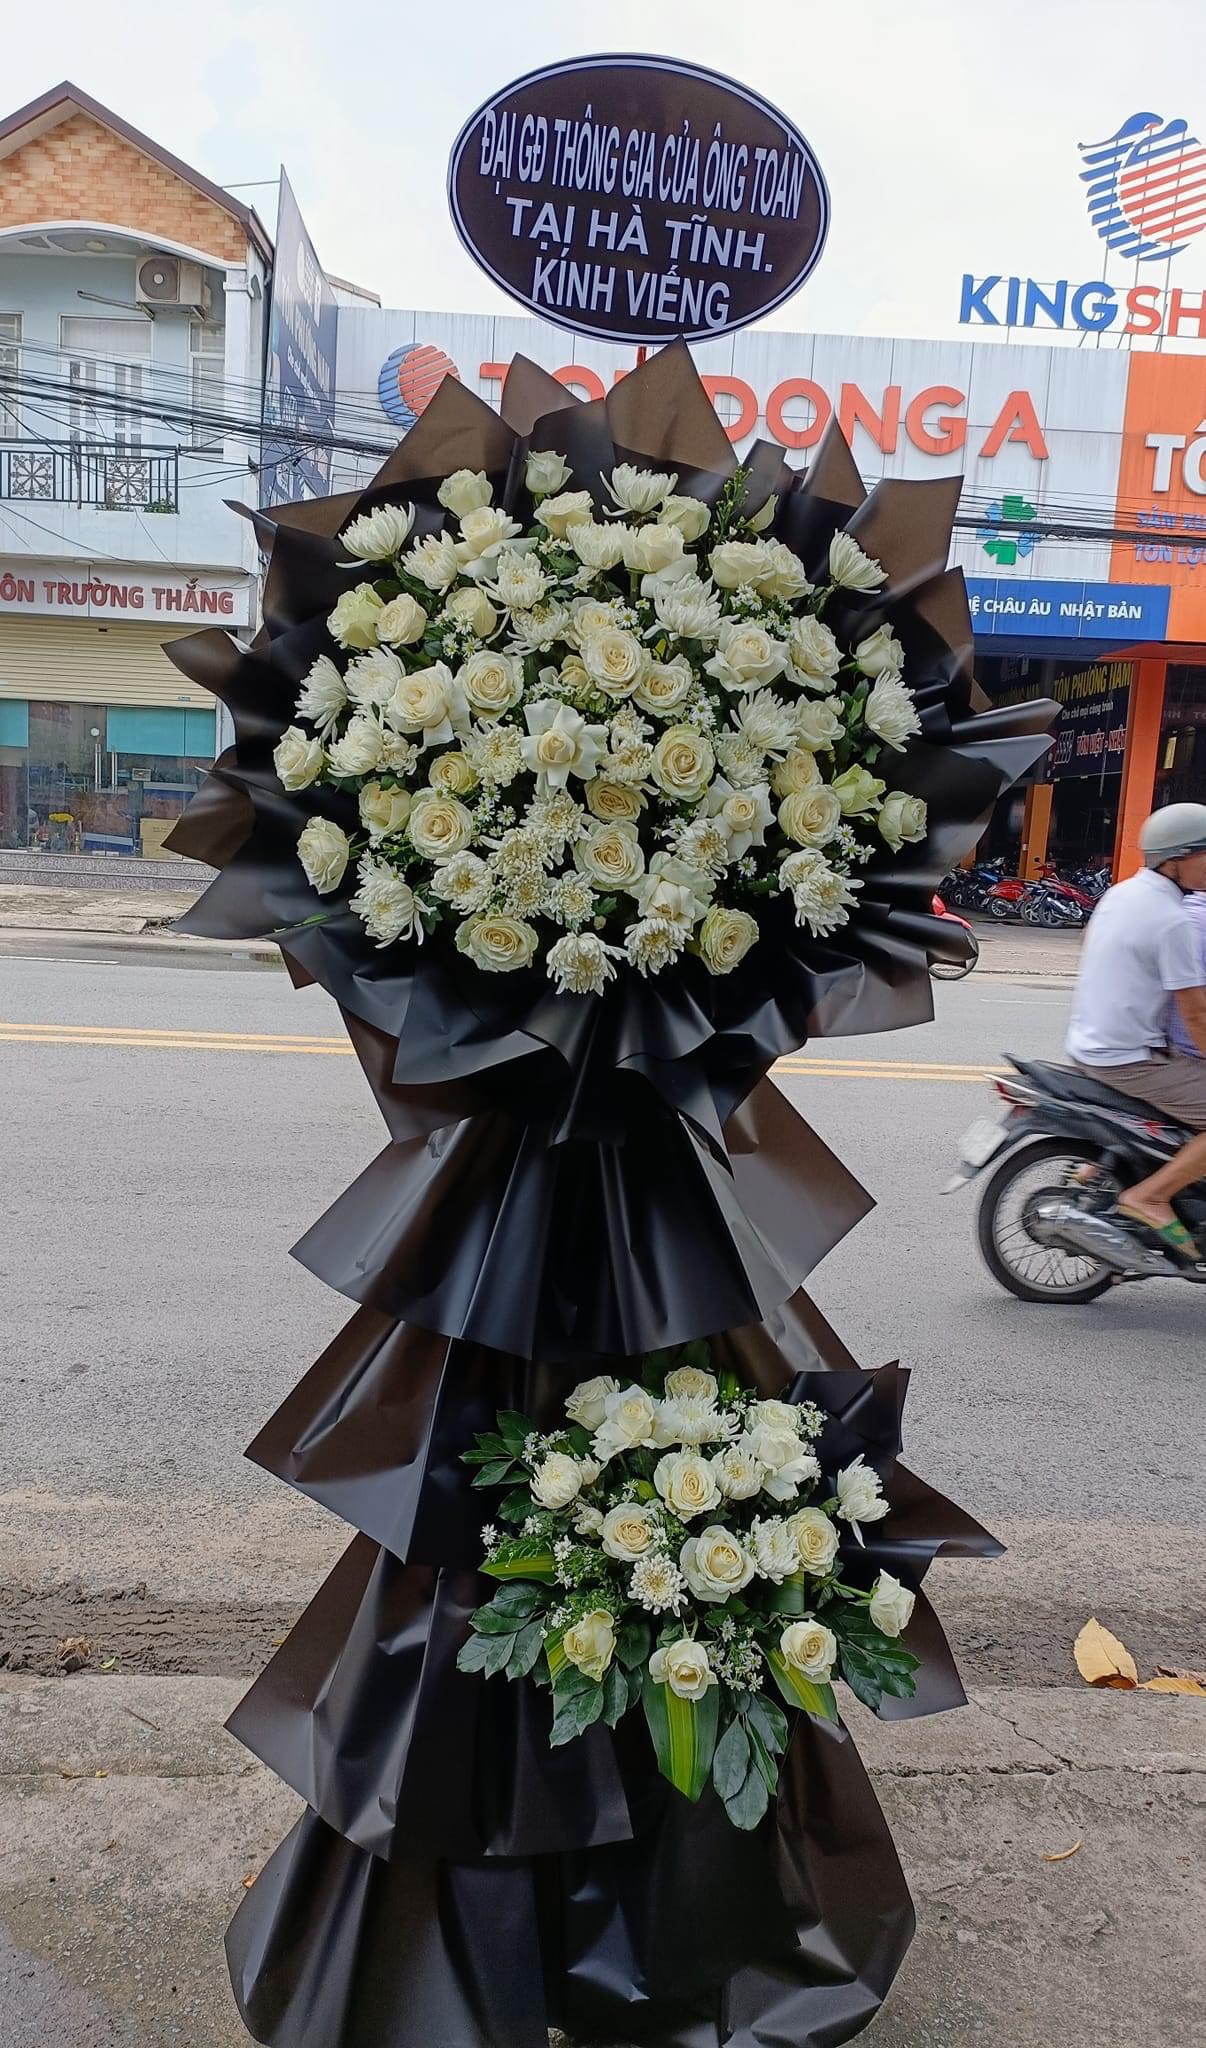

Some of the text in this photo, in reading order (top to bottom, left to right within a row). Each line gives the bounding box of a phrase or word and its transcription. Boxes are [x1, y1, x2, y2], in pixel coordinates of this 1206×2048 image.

[479, 109, 517, 195] ĐẠI
[518, 113, 548, 184] GĐ
[551, 104, 621, 194] THÔNG
[622, 128, 657, 200] GIA
[658, 119, 701, 206] CỦA
[702, 122, 750, 213] ÔNG
[506, 196, 774, 273] TẠI HÀ TĨNH.
[531, 247, 731, 330] KÍNH VIẾNG
[43, 576, 144, 608] TRƯỜNG
[152, 577, 234, 614] THẮNG
[983, 597, 1026, 614] CHÂU
[1028, 598, 1051, 616] ÂU
[1060, 600, 1105, 621] NHẬT
[1107, 600, 1142, 619] BẢN
